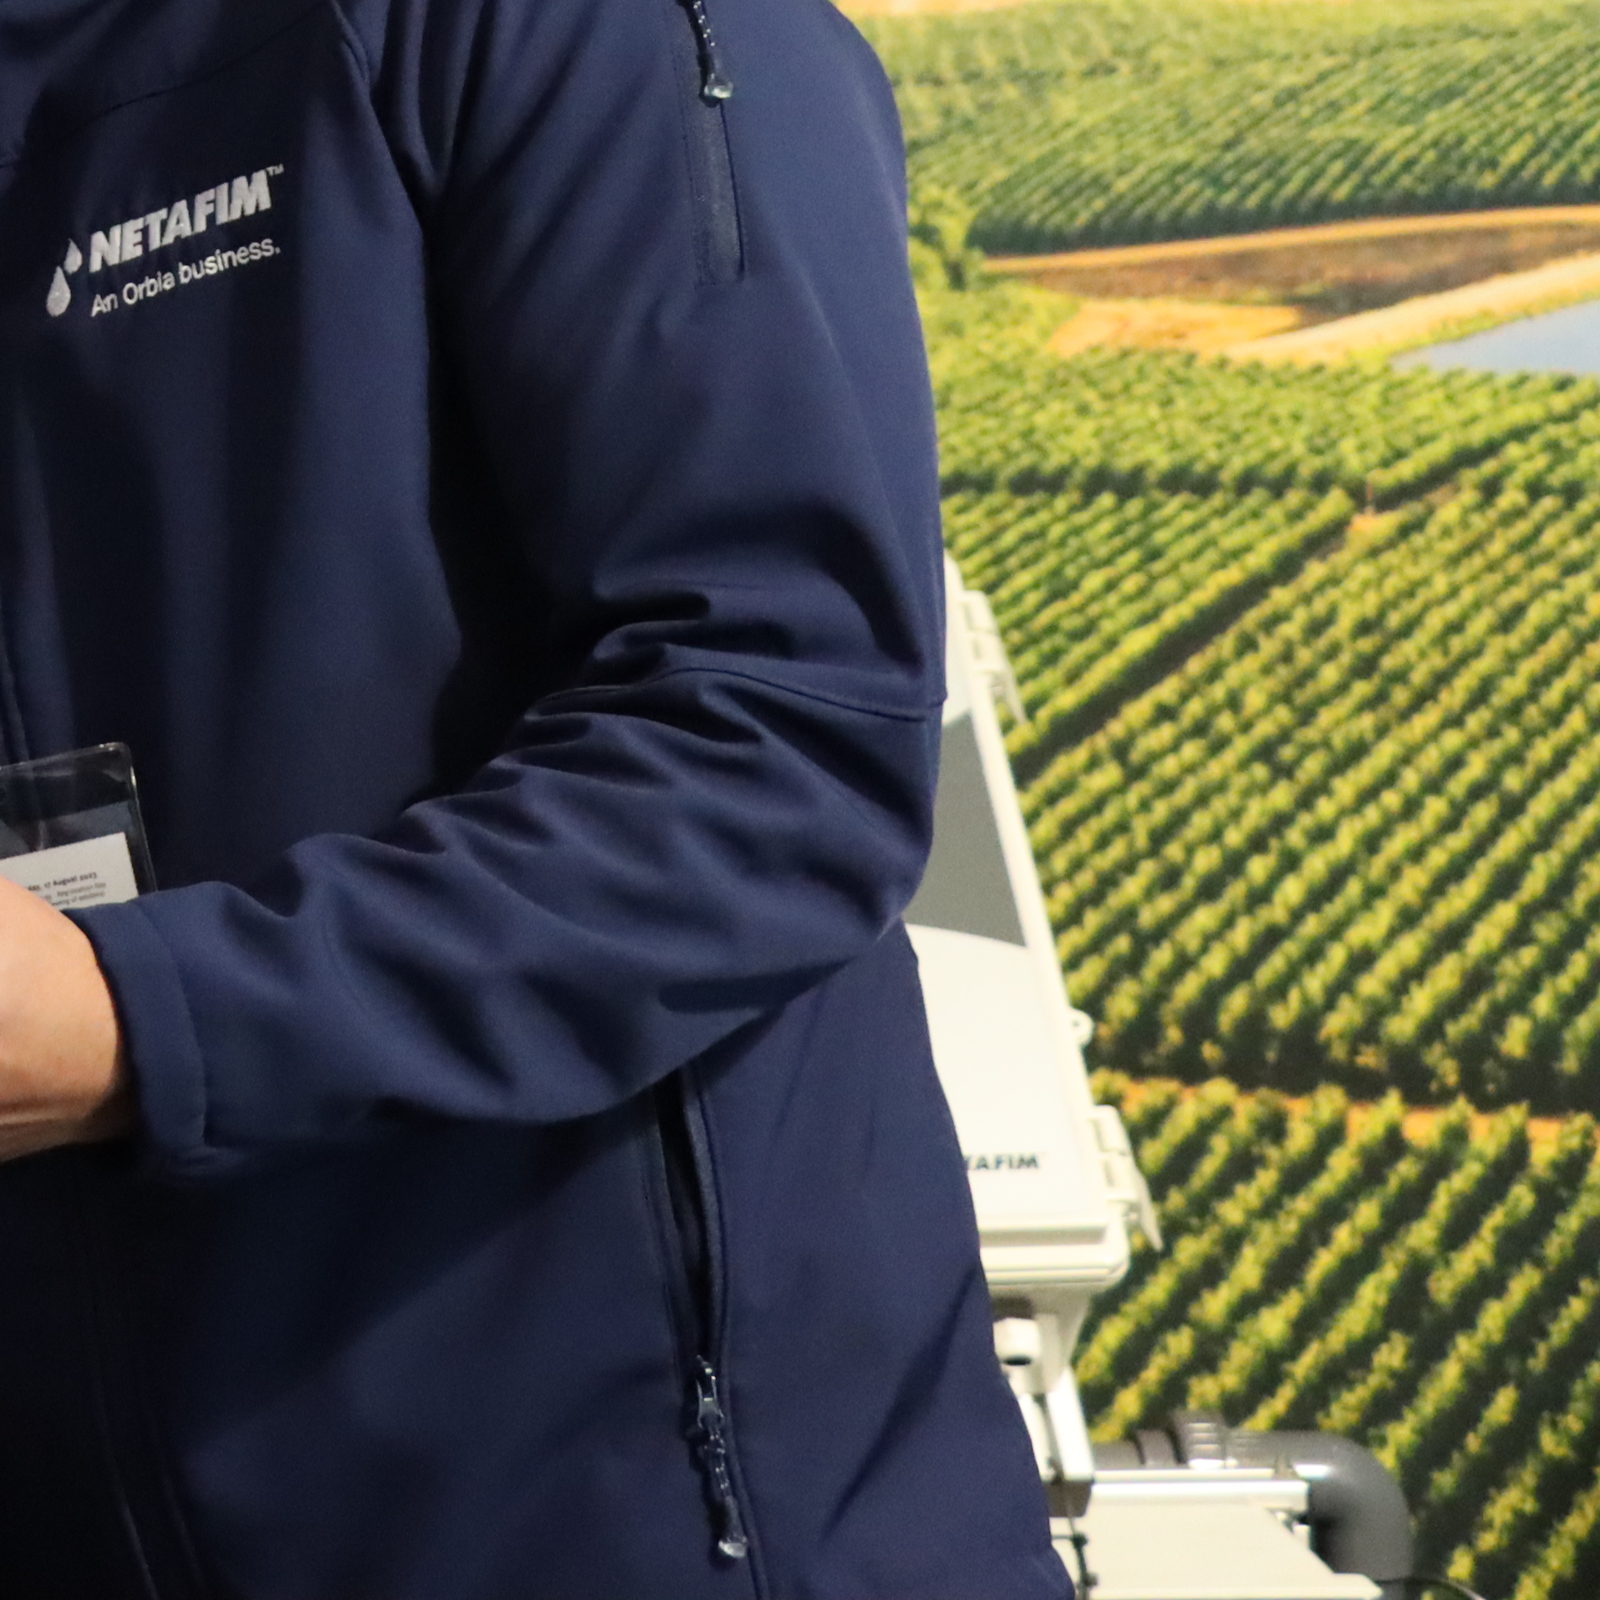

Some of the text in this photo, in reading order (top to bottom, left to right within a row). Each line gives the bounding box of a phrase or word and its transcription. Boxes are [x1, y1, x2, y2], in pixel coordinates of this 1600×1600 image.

[90, 238, 282, 318] An Orbia business.
